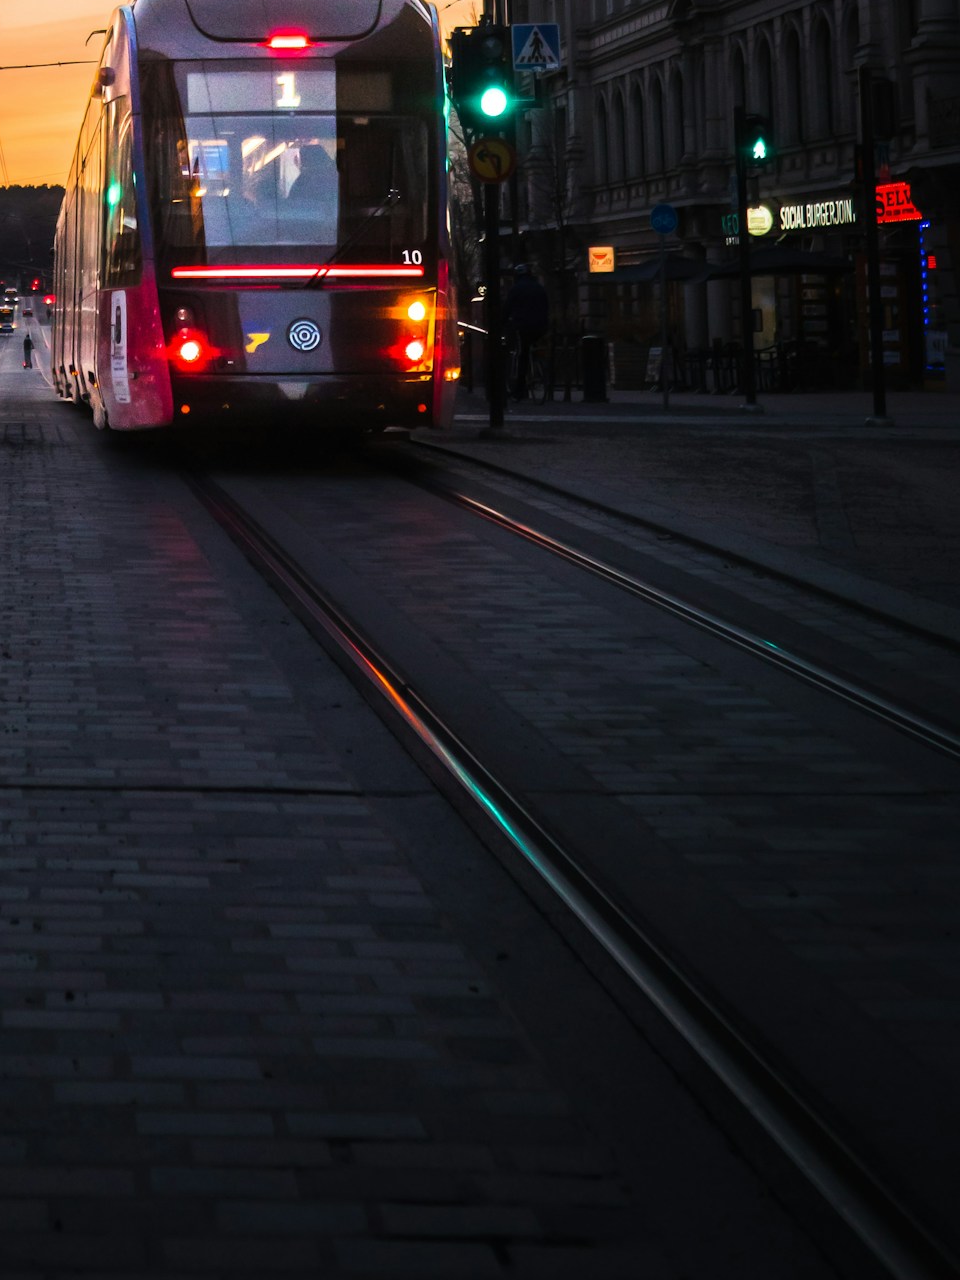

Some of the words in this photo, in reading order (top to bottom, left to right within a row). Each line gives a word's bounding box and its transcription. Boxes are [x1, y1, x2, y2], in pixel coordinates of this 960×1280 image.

[275, 70, 302, 108] 1
[780, 205, 806, 231] SOCIAL
[401, 249, 423, 266] 10
